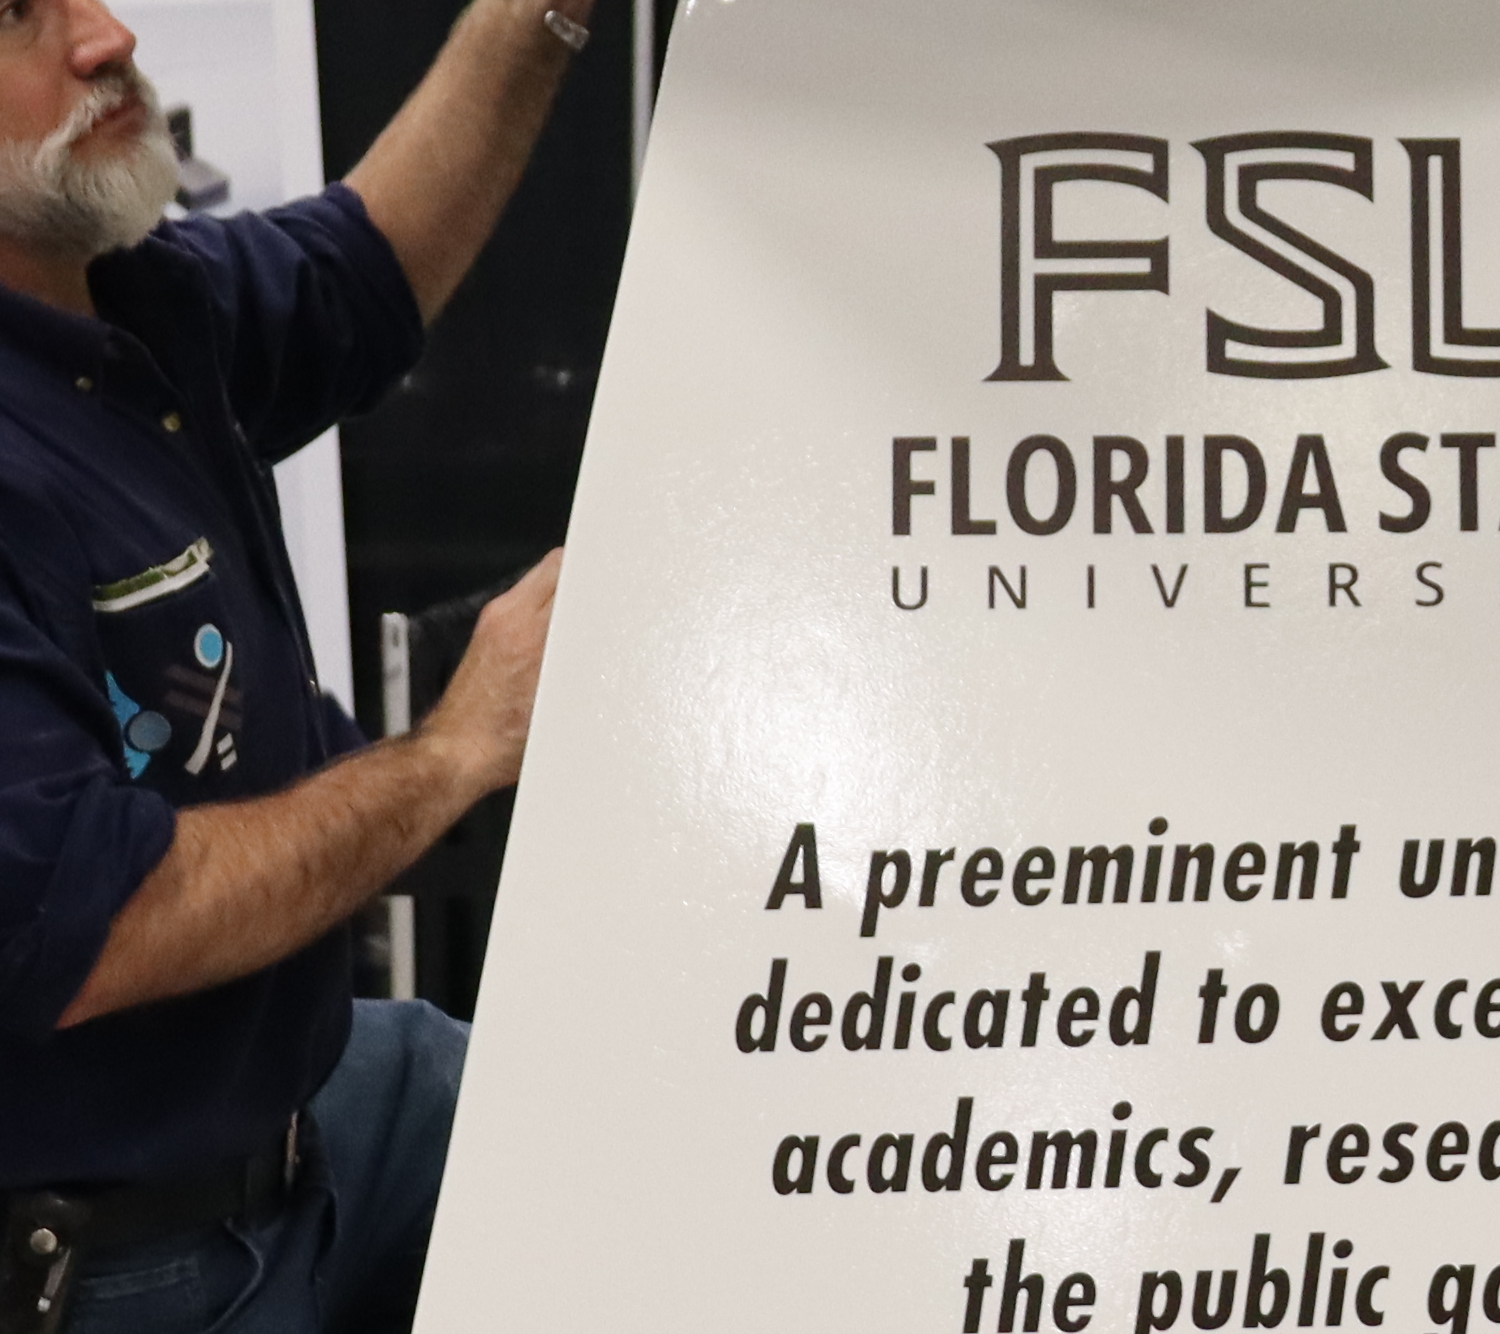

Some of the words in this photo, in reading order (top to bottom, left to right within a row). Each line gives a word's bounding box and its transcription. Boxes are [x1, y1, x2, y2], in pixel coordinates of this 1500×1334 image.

[891, 434, 1348, 537] FLORIDA
[764, 823, 823, 911] A
[859, 817, 1362, 939] preeminent
[734, 950, 1162, 1055] dedicated
[1197, 968, 1281, 1045] to
[771, 1096, 1241, 1204] academics,
[962, 1238, 1098, 1334] the
